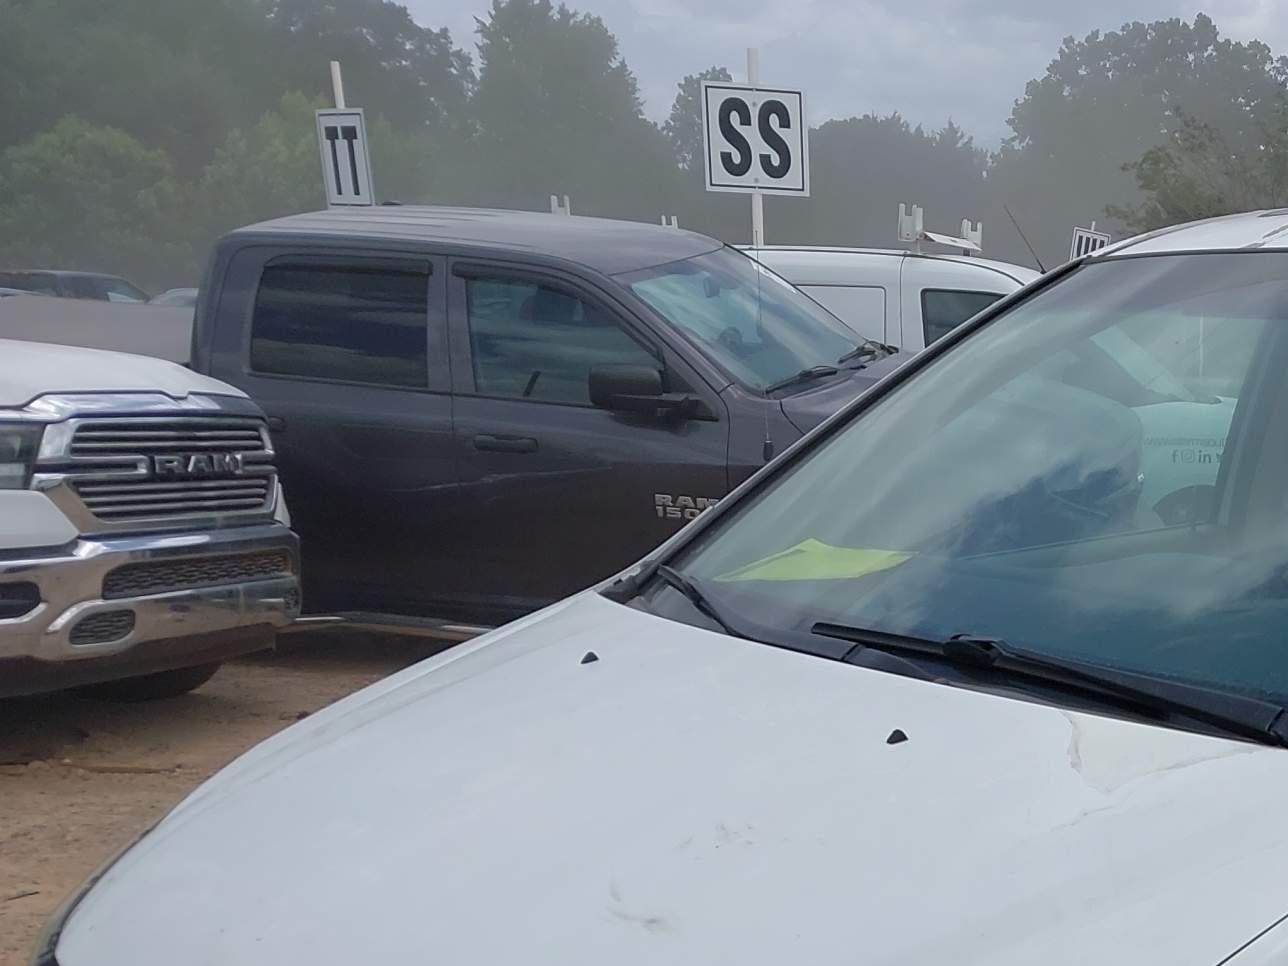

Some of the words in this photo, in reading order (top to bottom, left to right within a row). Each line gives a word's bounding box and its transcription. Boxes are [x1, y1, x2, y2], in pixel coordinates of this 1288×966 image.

[719, 97, 791, 179] SS
[324, 126, 360, 195] TT
[154, 455, 242, 474] RAM
[654, 493, 720, 511] RAM
[655, 505, 702, 519] 150
